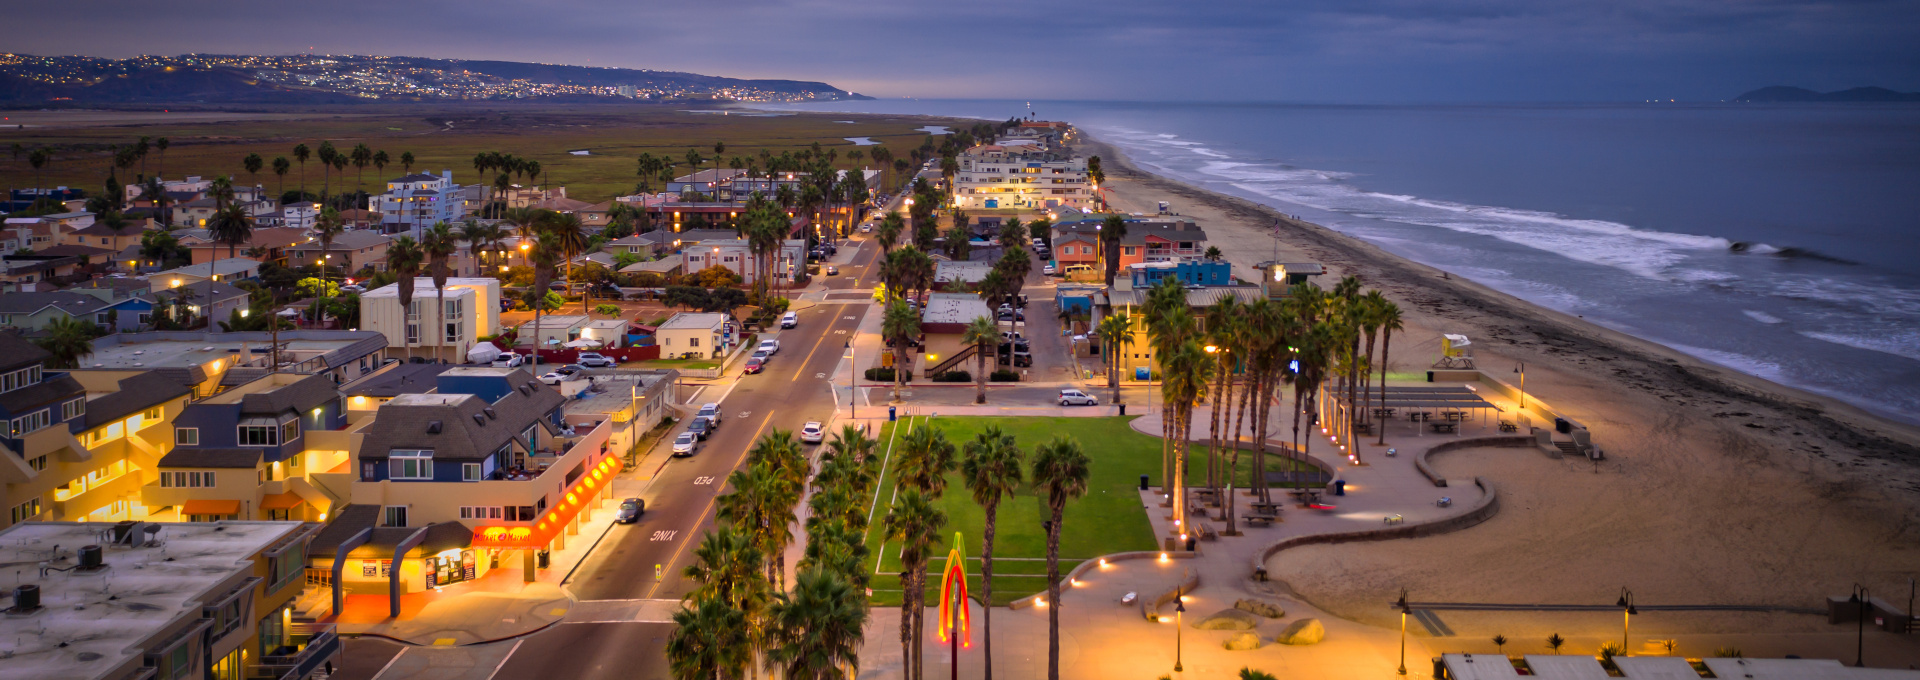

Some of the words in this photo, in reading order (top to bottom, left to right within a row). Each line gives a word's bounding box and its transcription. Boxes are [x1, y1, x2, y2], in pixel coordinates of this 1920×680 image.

[693, 476, 715, 485] PED
[473, 533, 496, 542] Market
[508, 533, 530, 542] Market
[650, 530, 678, 542] XING
